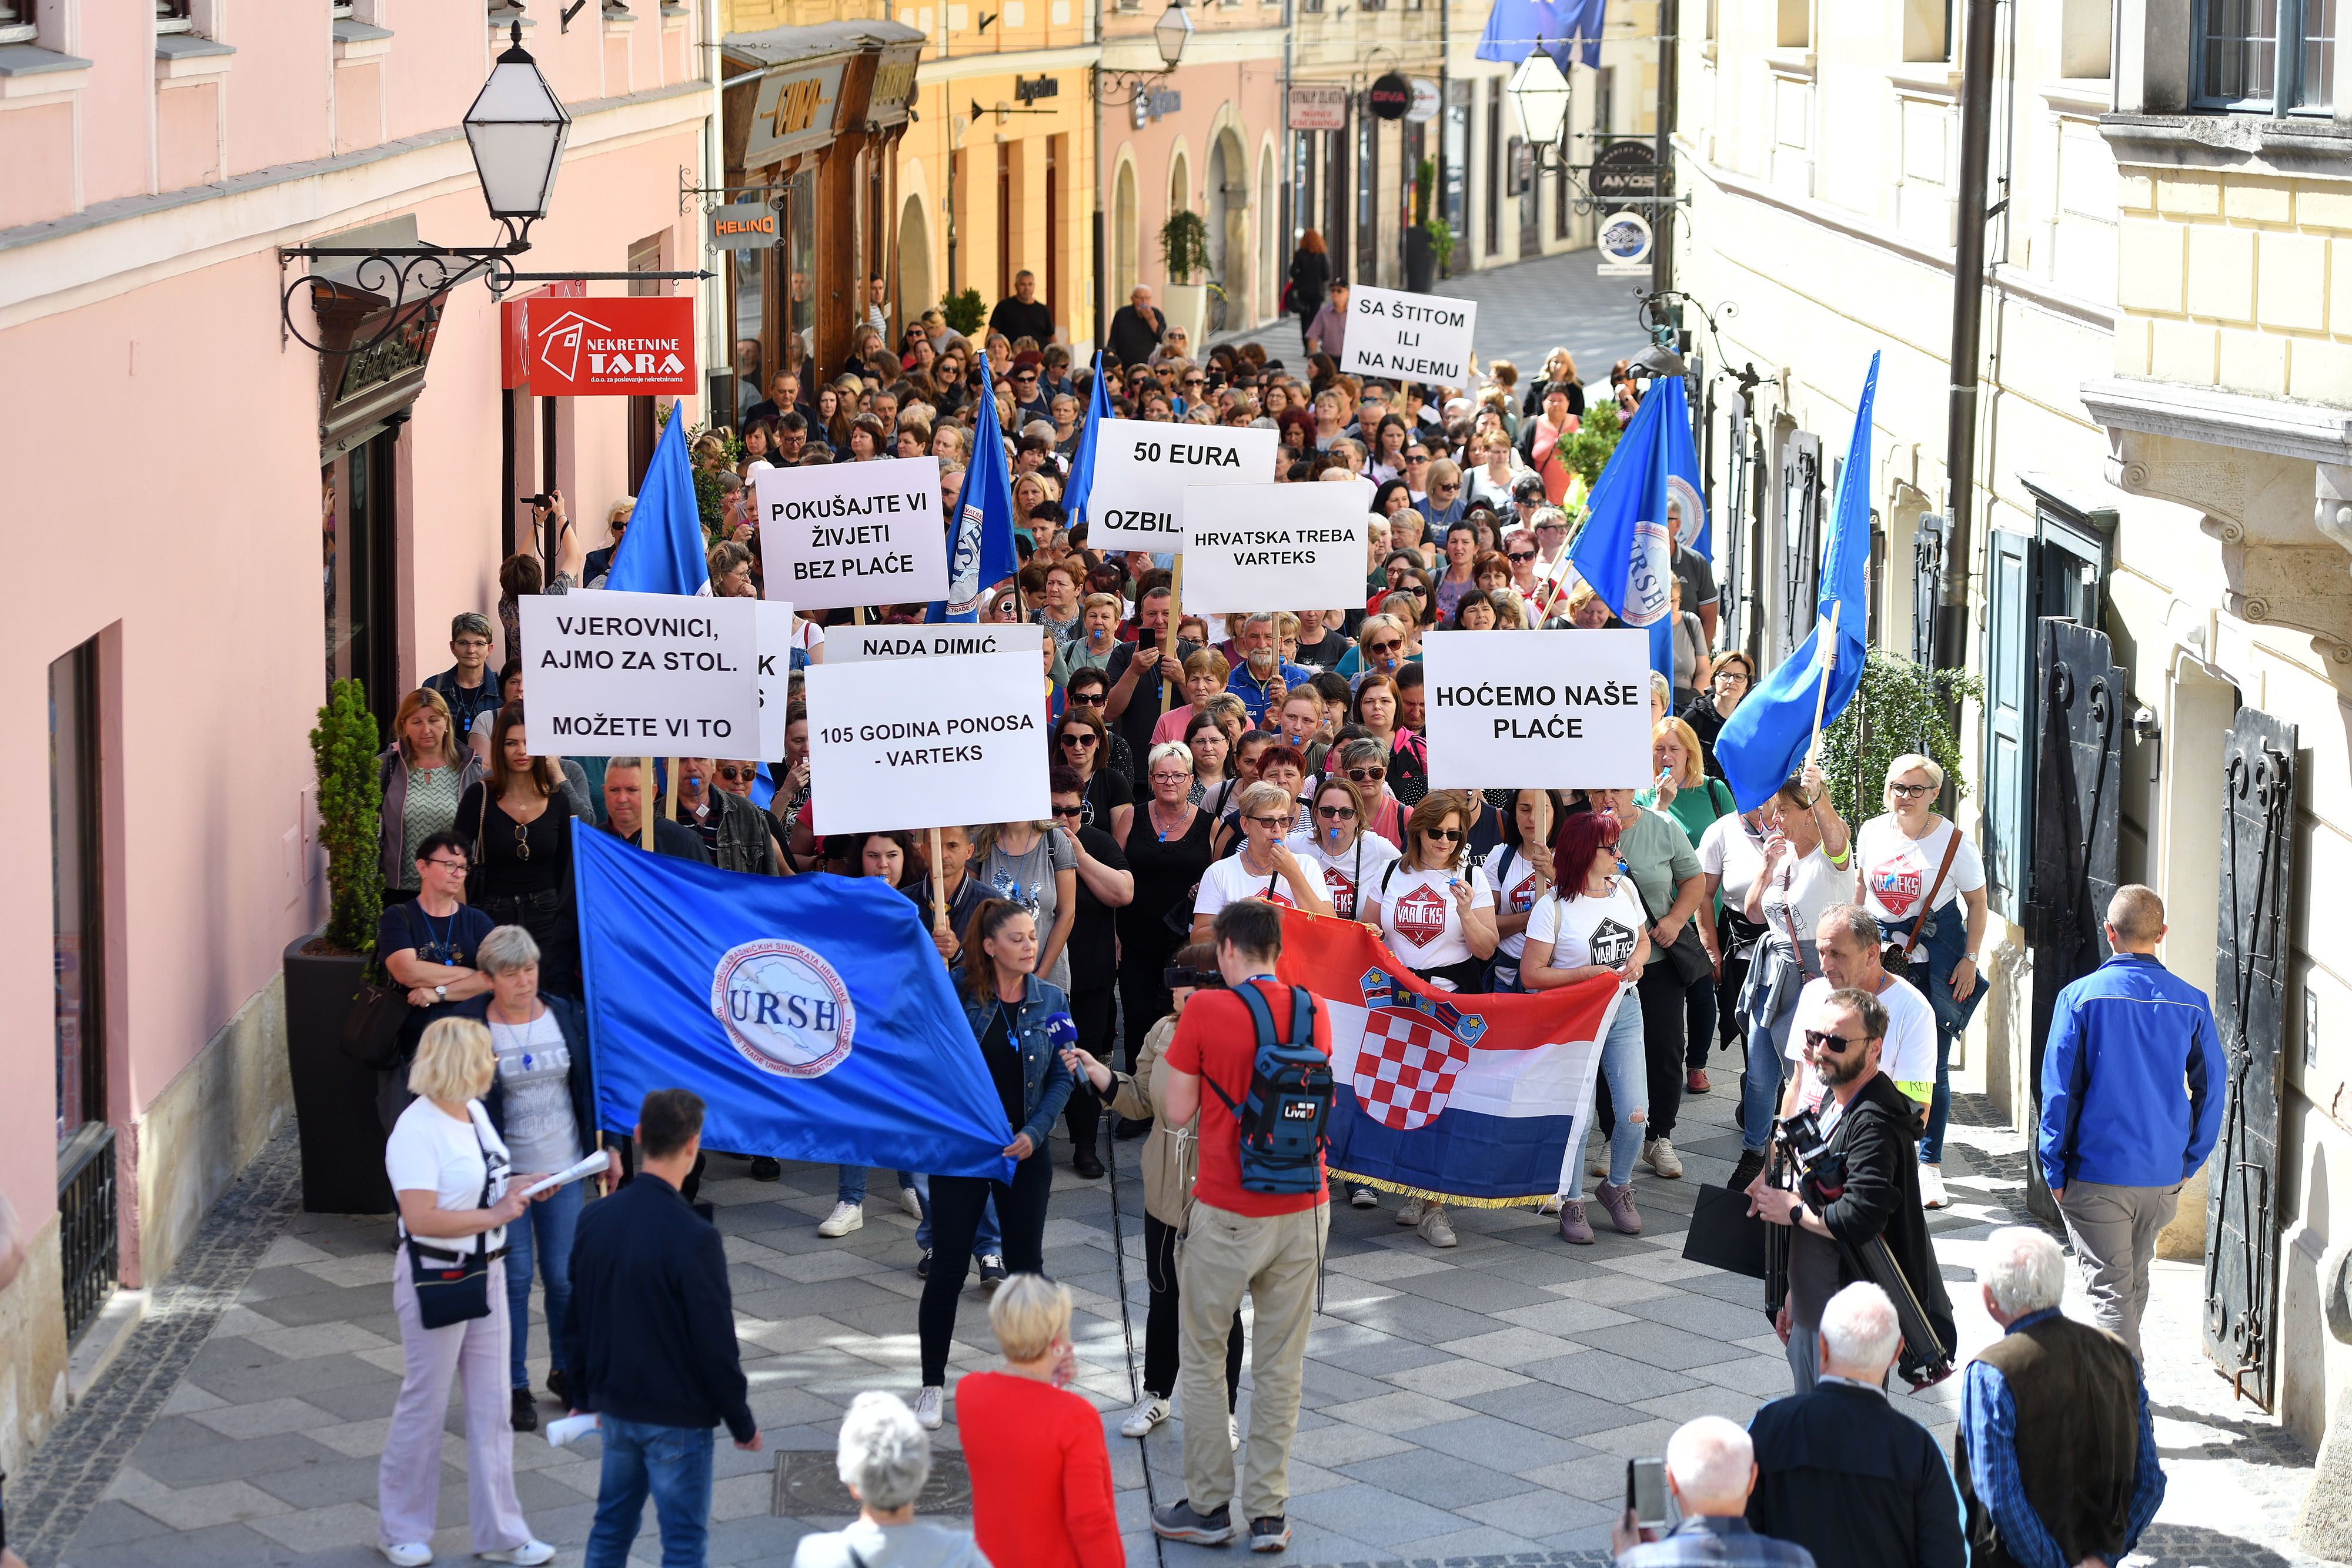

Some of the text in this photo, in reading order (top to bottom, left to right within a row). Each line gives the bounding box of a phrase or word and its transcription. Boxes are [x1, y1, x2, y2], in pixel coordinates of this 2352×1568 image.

[1372, 91, 1405, 102] DIVA
[716, 216, 773, 237] HELINO
[1359, 299, 1465, 328] SA ŠTITOM
[587, 338, 680, 351] NEKRETNINE
[1398, 331, 1419, 347] ILI
[587, 353, 686, 375] TARA
[1358, 351, 1458, 378] NA NJEMU
[1134, 442, 1240, 467] 50 EURA
[771, 493, 927, 521] POKUŠAJTE VI
[1104, 510, 1184, 533] OZBIL
[812, 524, 890, 547] ŽIVJETI
[1195, 529, 1355, 546] HRVATSKA TREBA
[794, 551, 914, 580] BEZ PLAĆE
[1233, 550, 1315, 566] VARTEKS
[951, 605, 970, 613] TRADE
[556, 616, 718, 641] VJEROVNICI,
[863, 639, 927, 656] NADA
[540, 650, 737, 671] AJMO ZA STOL.
[1436, 681, 1638, 707] HOĆEMO NAŠE
[553, 713, 731, 738] MOŽETE VI TO
[821, 714, 1034, 744] 105 GODINA PONOSA
[1494, 714, 1583, 738] PLAĆE
[886, 745, 983, 767] VARTEKS
[1398, 900, 1443, 924] VARTEKS
[715, 942, 848, 1005] UDRUGA RADNIČKIH SINDIKATA HRVATSKE
[729, 989, 836, 1031] URSH
[741, 1044, 764, 1065] TRADE
[765, 1061, 790, 1074] UNION
[835, 1049, 845, 1059] OF
